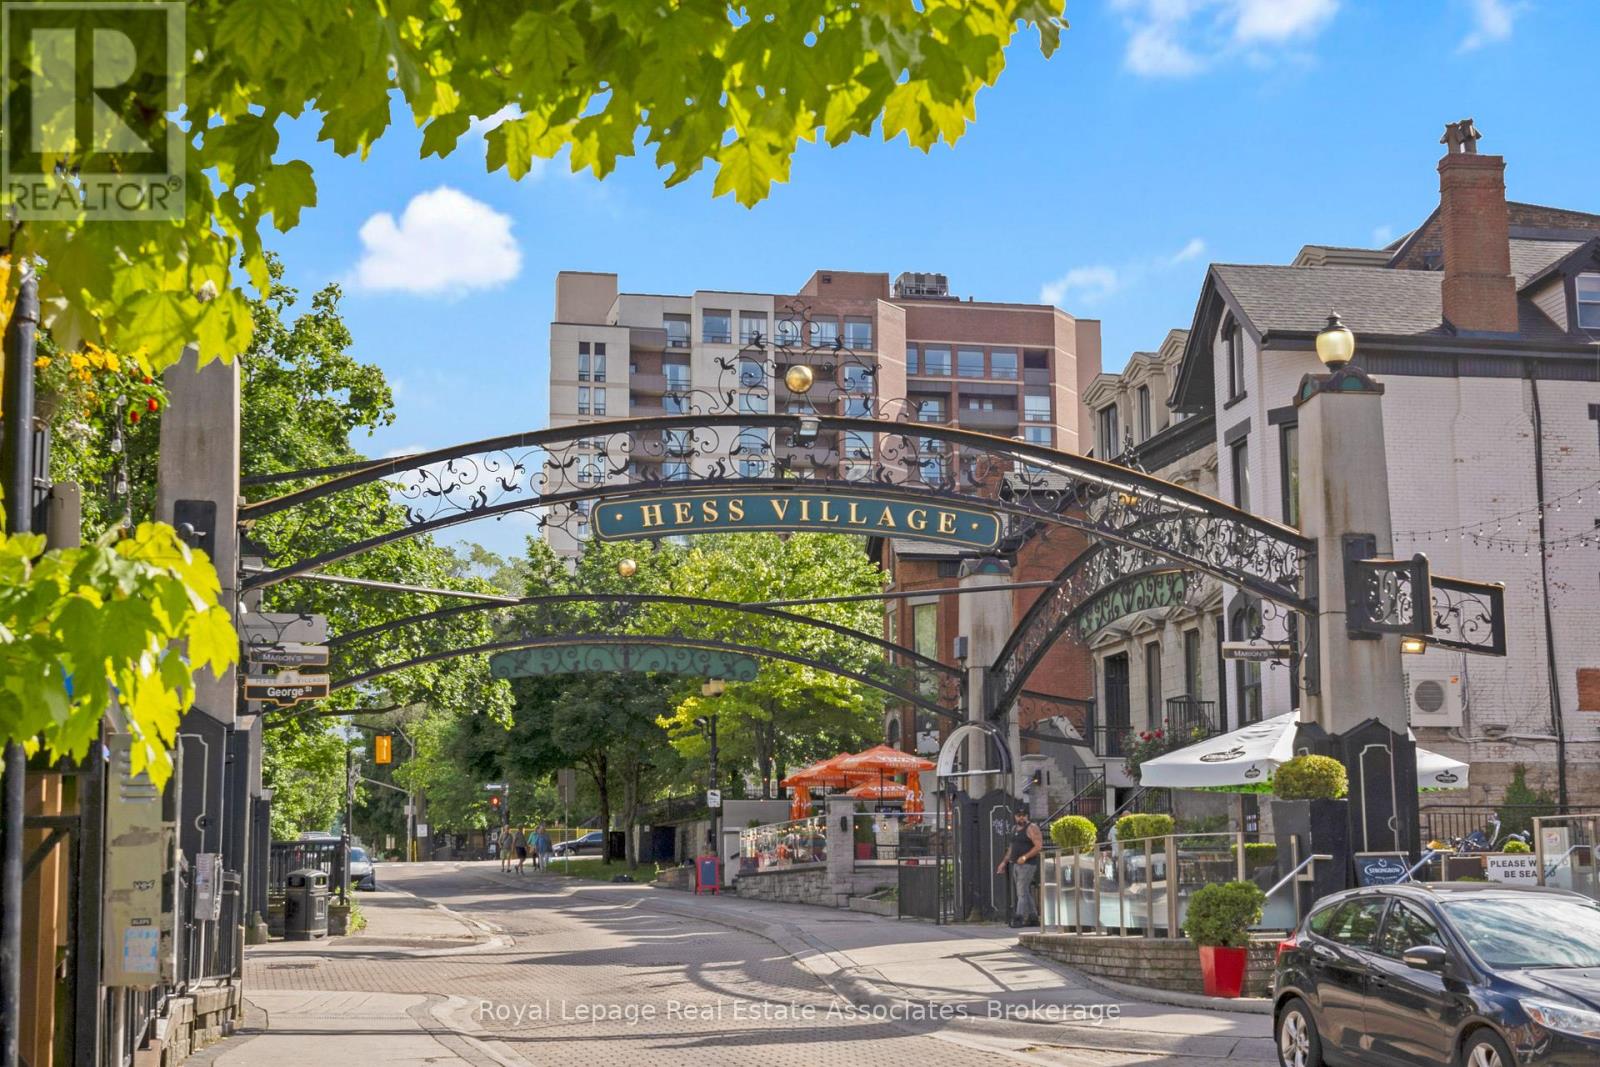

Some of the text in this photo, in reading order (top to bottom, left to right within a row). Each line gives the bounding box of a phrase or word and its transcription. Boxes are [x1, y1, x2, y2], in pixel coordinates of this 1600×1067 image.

[640, 498, 958, 535] HESS VILLAGE
[266, 687, 304, 698] George
[1490, 860, 1526, 868] PLEASE
[1504, 870, 1516, 878] BE
